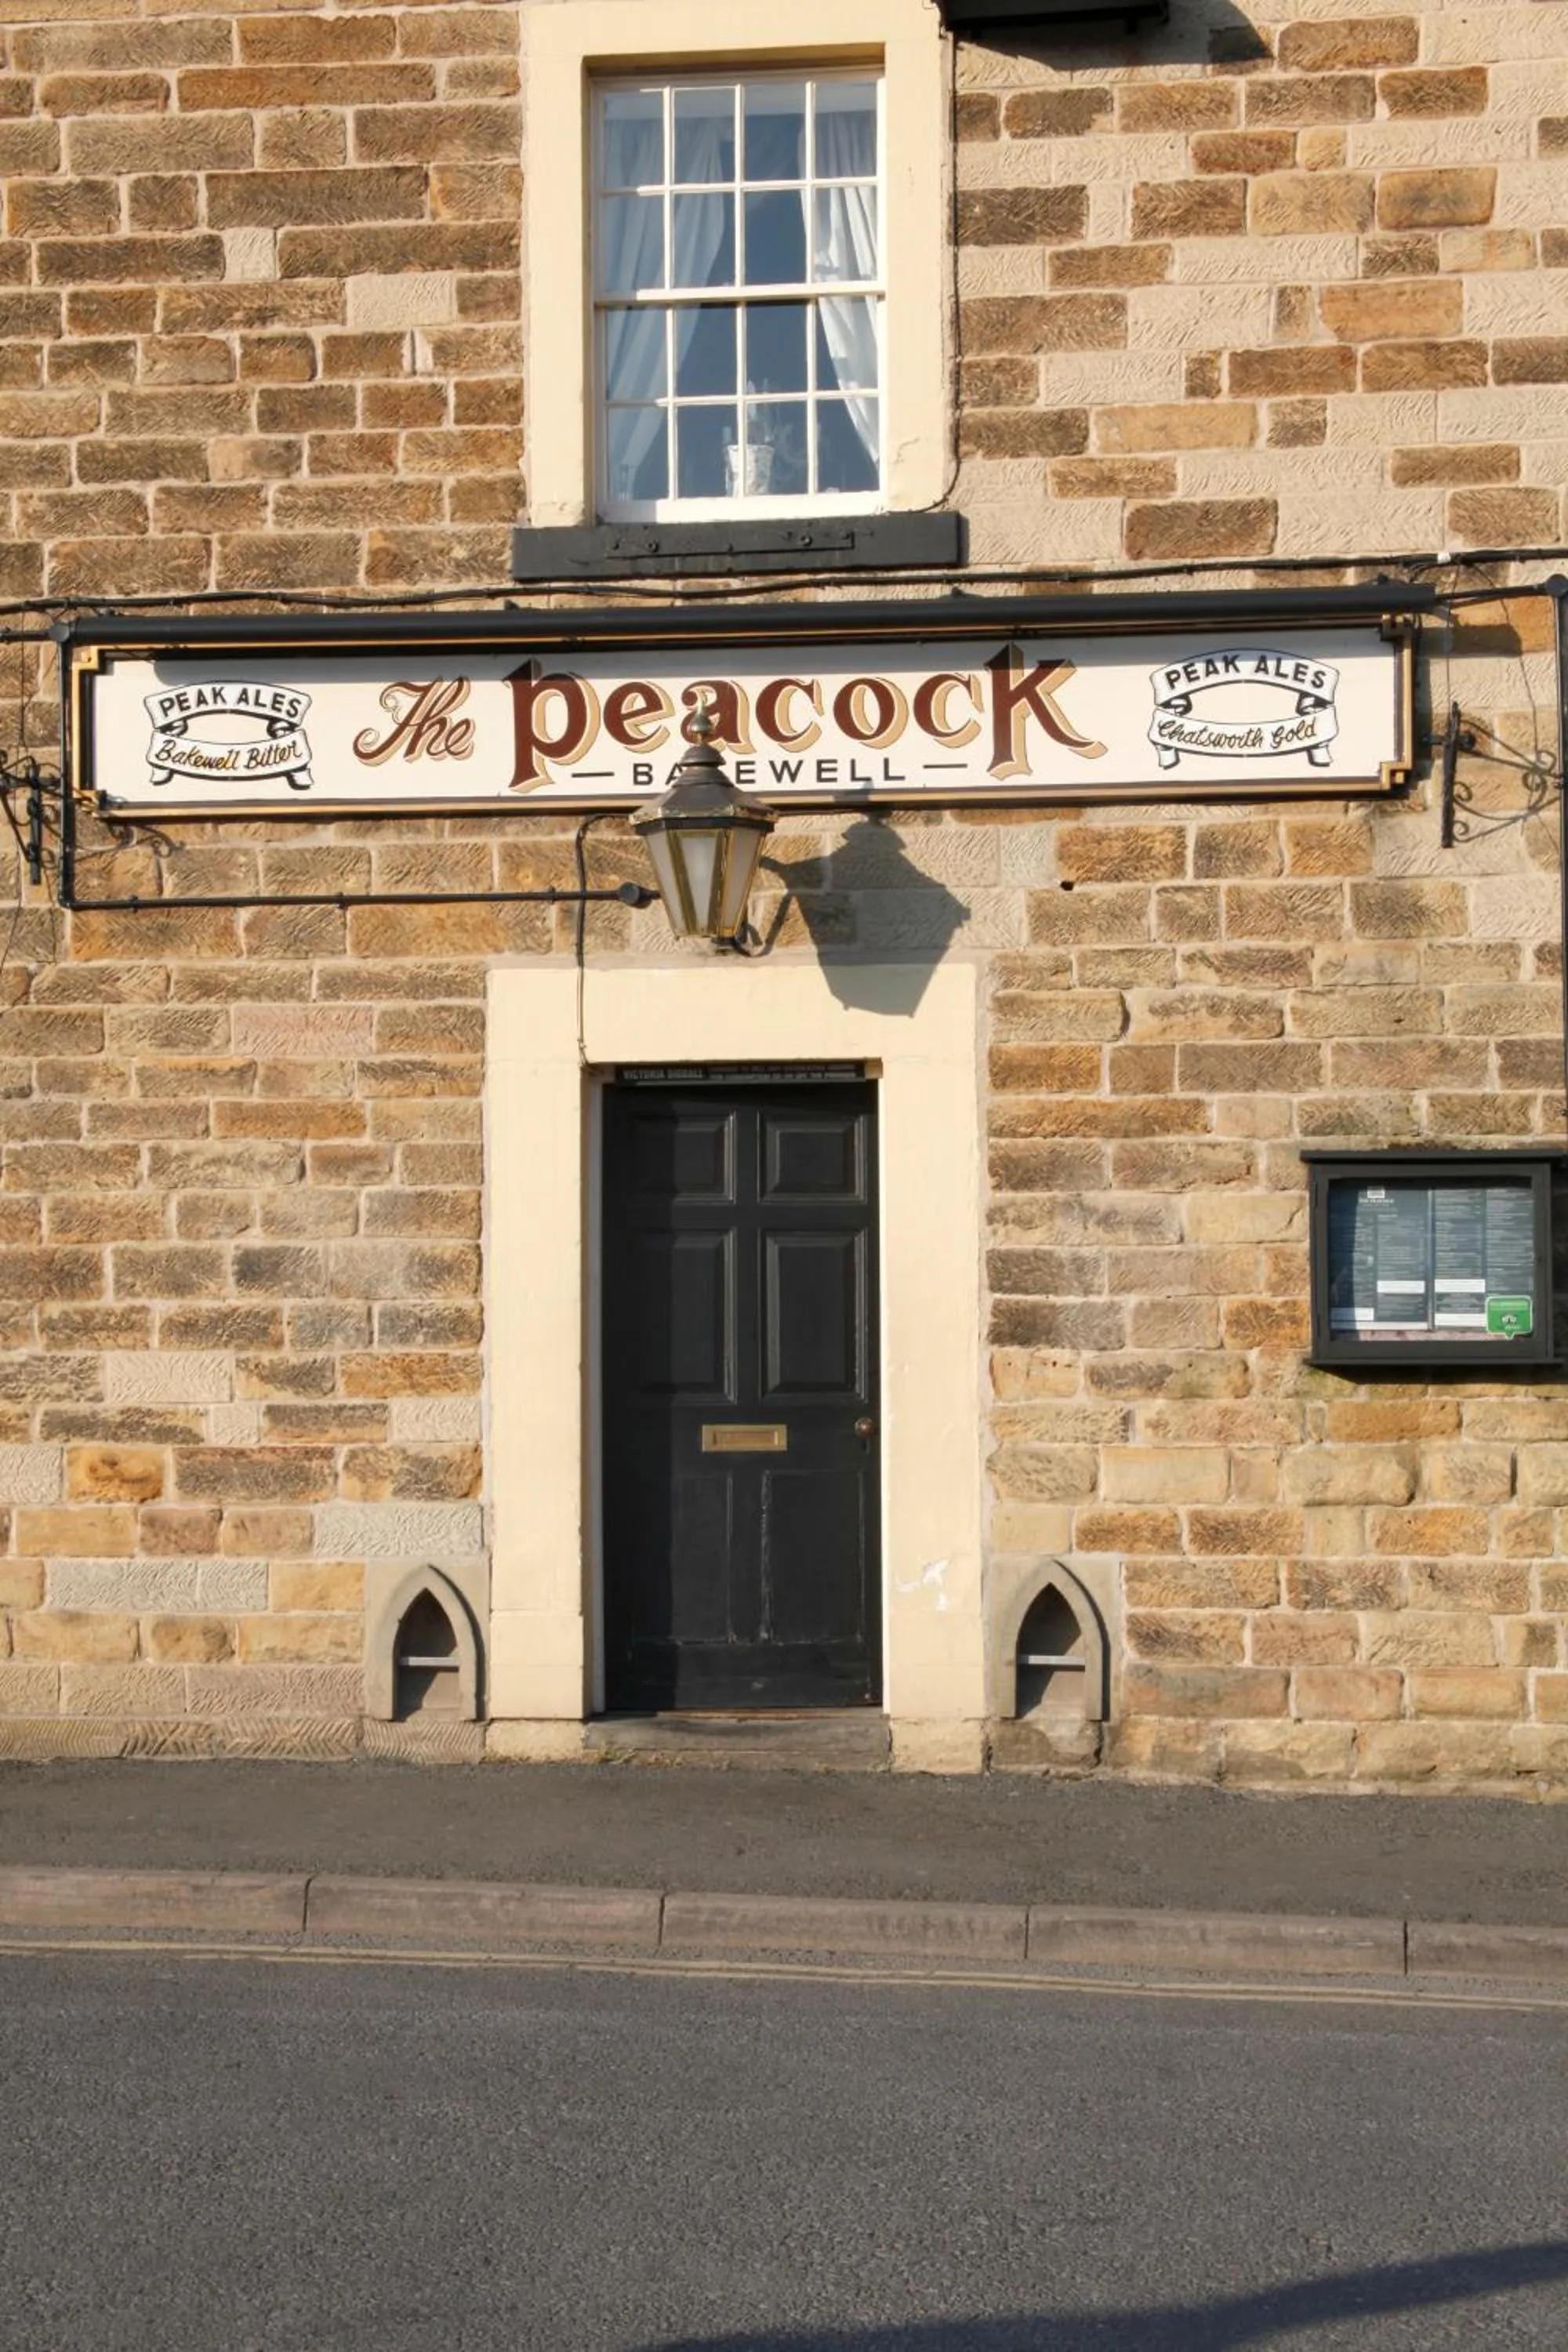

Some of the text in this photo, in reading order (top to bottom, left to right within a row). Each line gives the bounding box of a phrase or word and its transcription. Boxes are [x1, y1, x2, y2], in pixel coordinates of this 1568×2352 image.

[1165, 655, 1327, 690] PEAK ALES
[159, 687, 302, 718] PEAK ALES
[353, 676, 476, 766] The
[1158, 717, 1317, 750] Chatsworth Gold
[154, 739, 303, 769] Bakewell Bitter
[632, 757, 906, 786] BAEWELL
